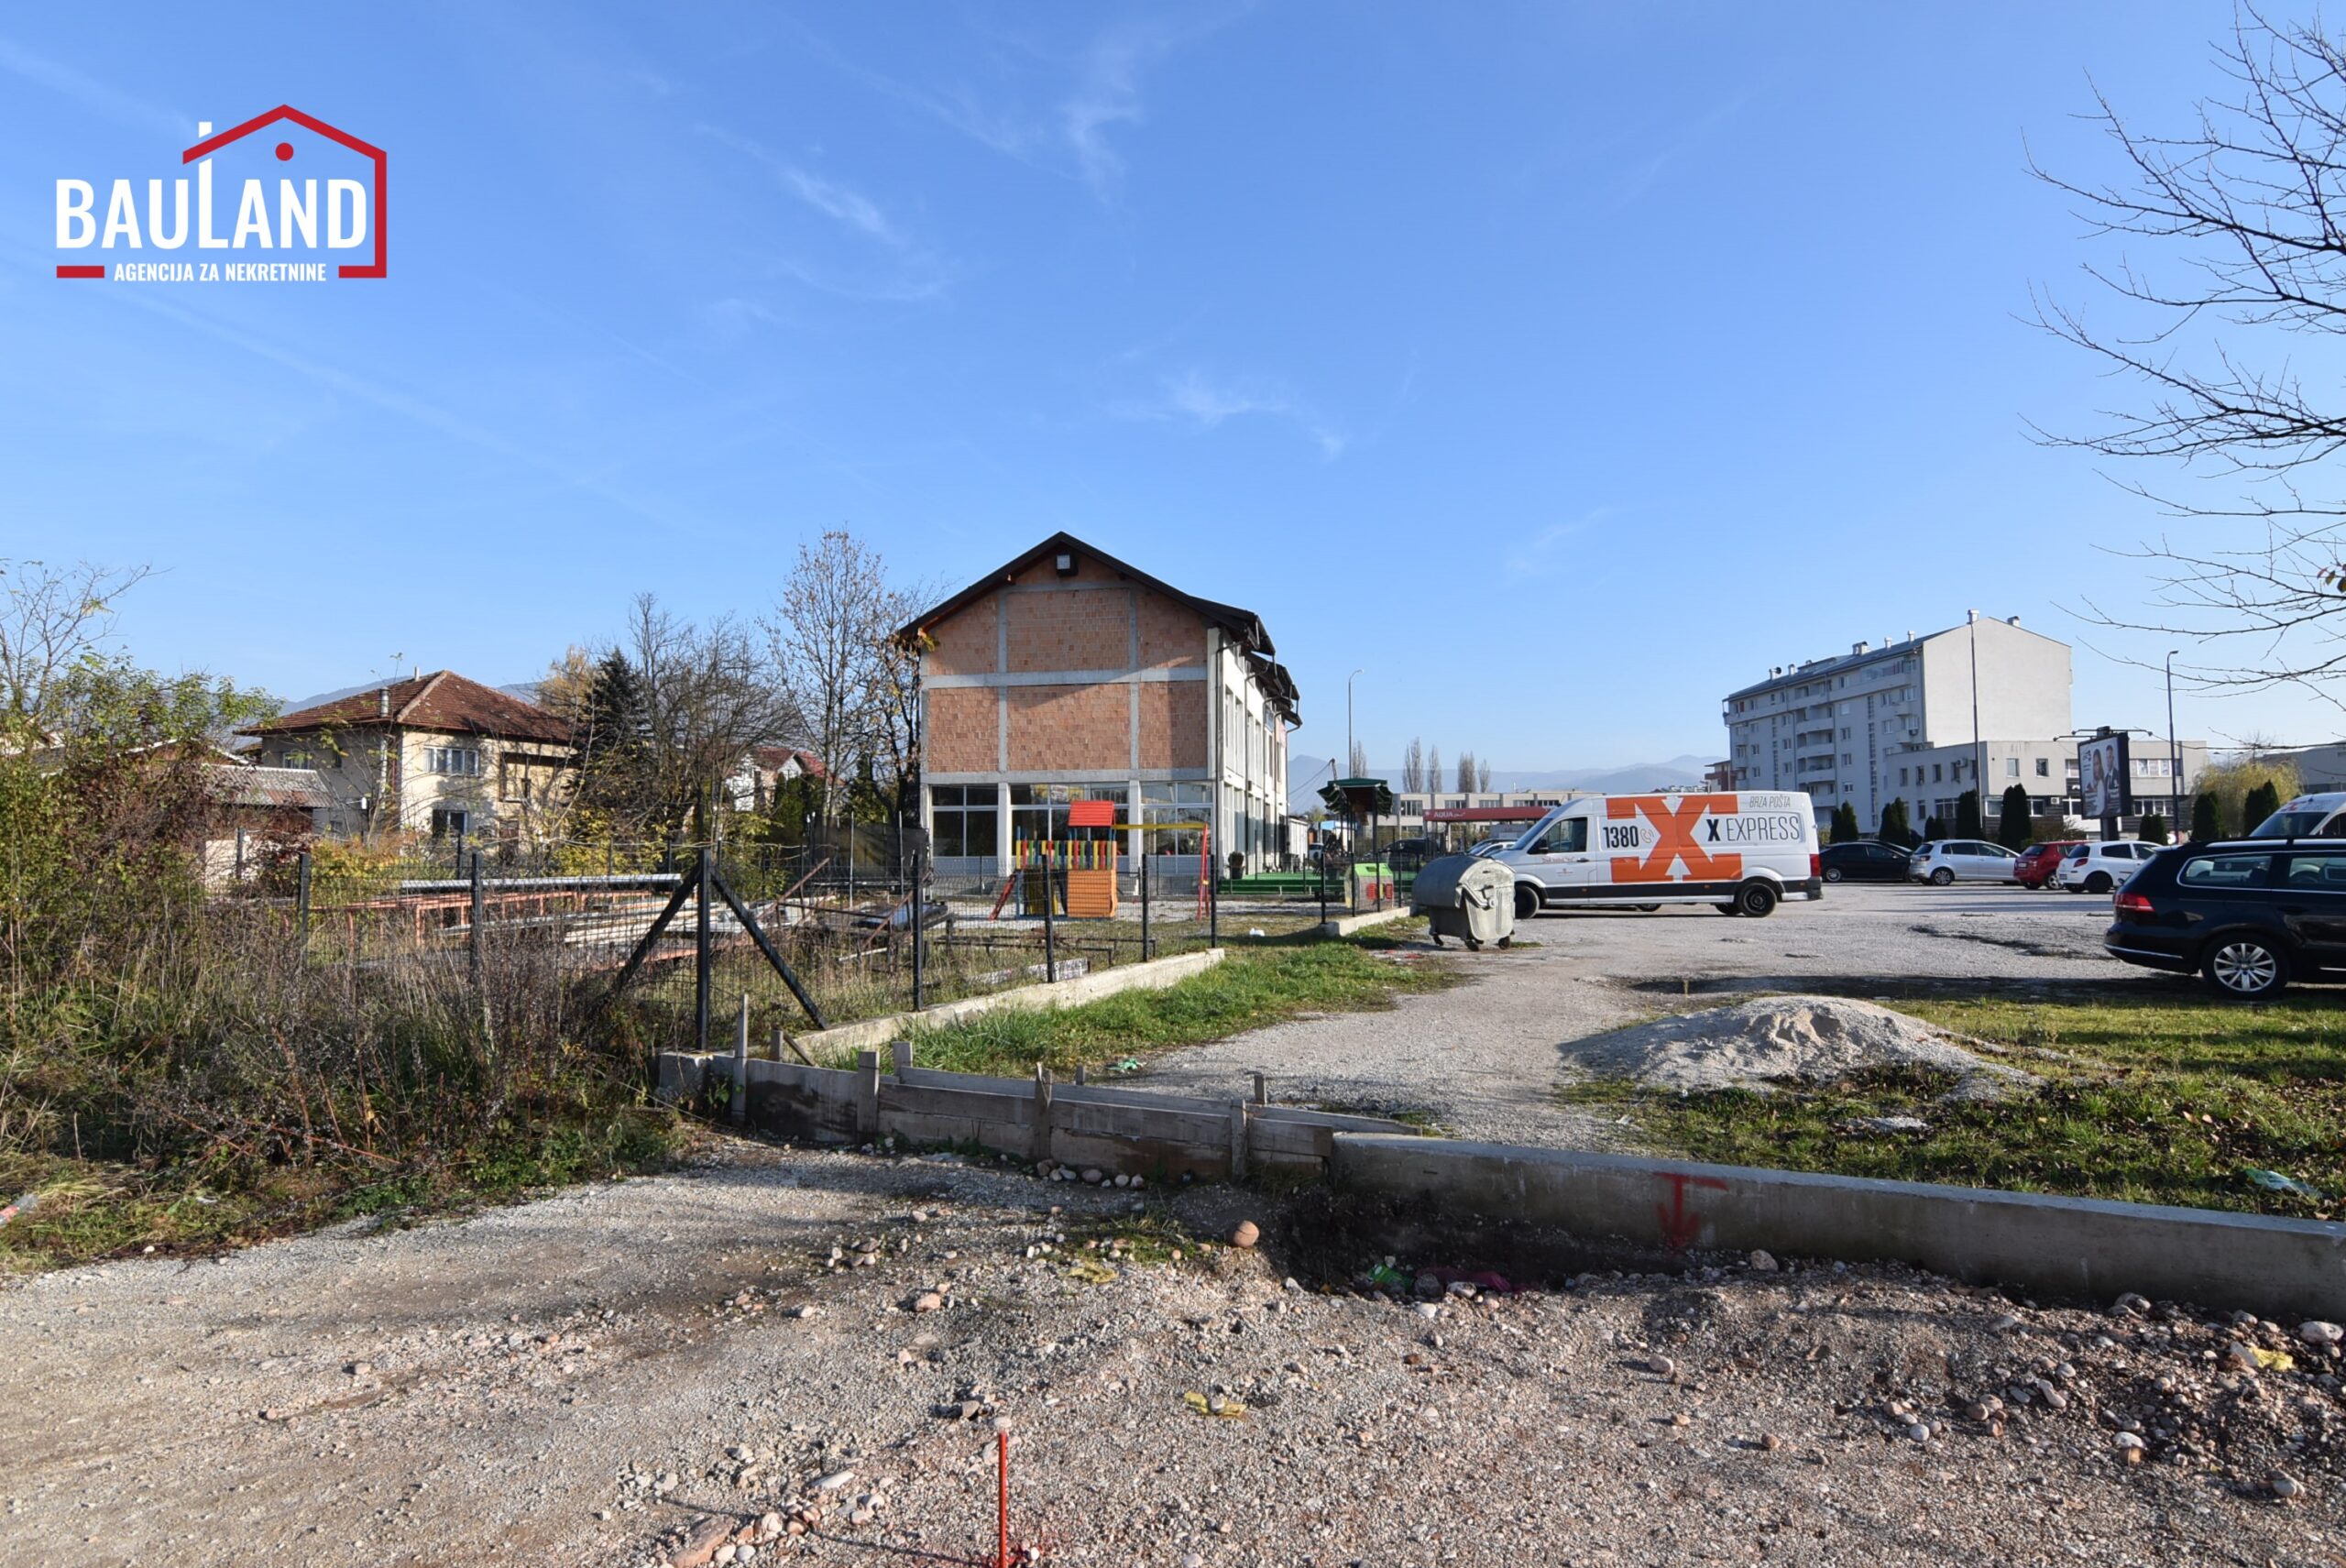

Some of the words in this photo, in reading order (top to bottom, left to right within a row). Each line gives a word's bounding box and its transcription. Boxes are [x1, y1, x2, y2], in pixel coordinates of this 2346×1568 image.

[1749, 796, 1768, 808] BRZA
[1770, 795, 1791, 808] POŠTA
[1603, 826, 1639, 849] 1380
[1706, 818, 1720, 842] X
[1727, 816, 1800, 841] EXPRESS
